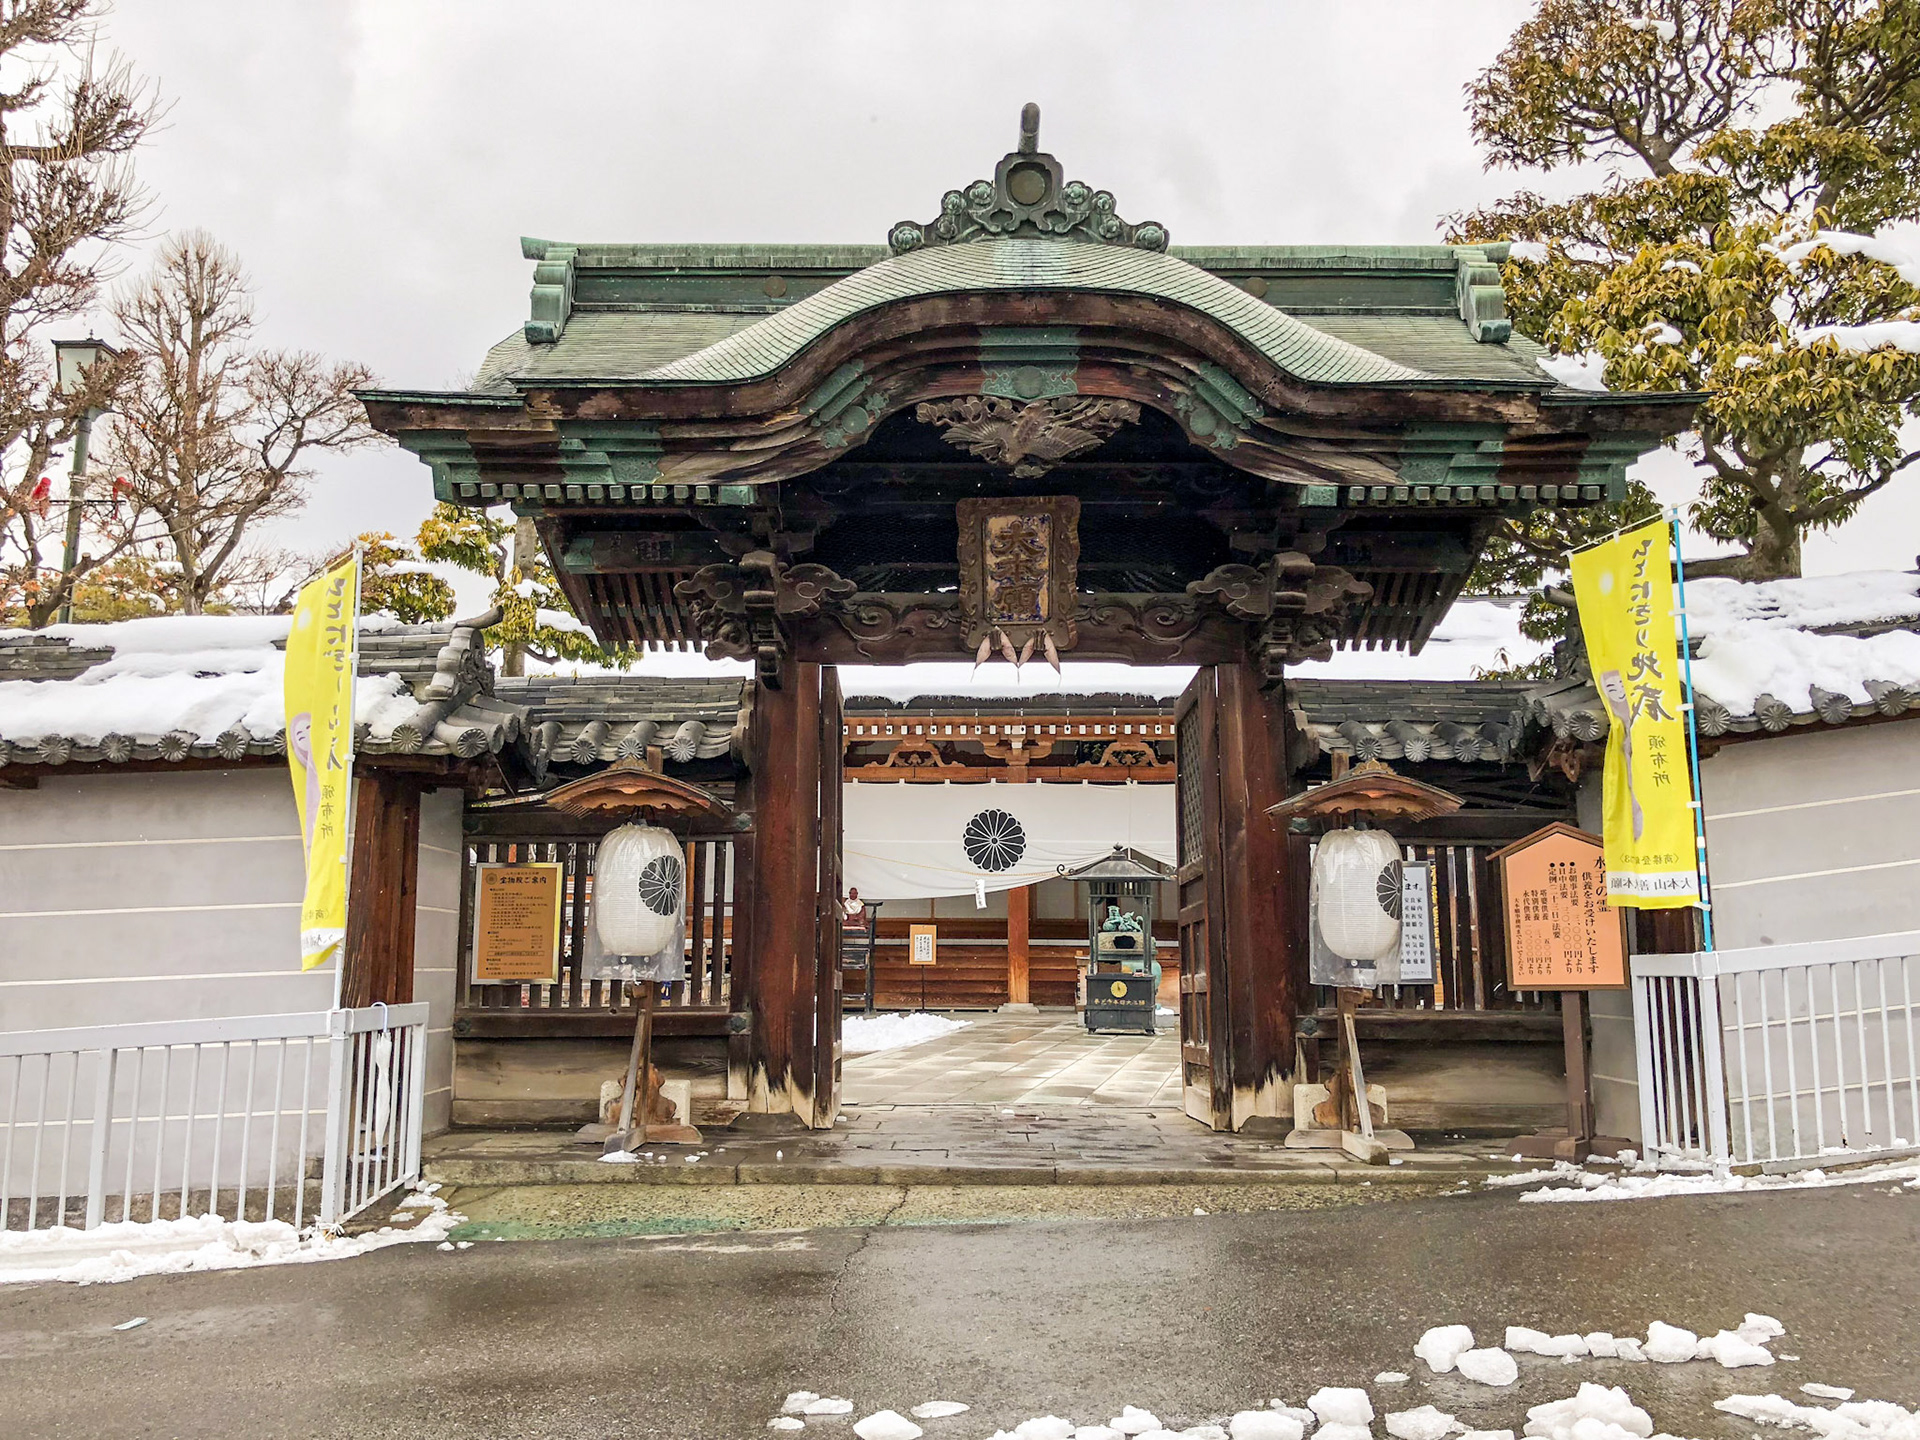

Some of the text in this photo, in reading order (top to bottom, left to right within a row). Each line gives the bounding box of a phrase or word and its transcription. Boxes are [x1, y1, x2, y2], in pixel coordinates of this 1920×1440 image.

[990, 520, 1047, 616] 大本願
[1582, 871, 1599, 974] 供養をお受けいたします
